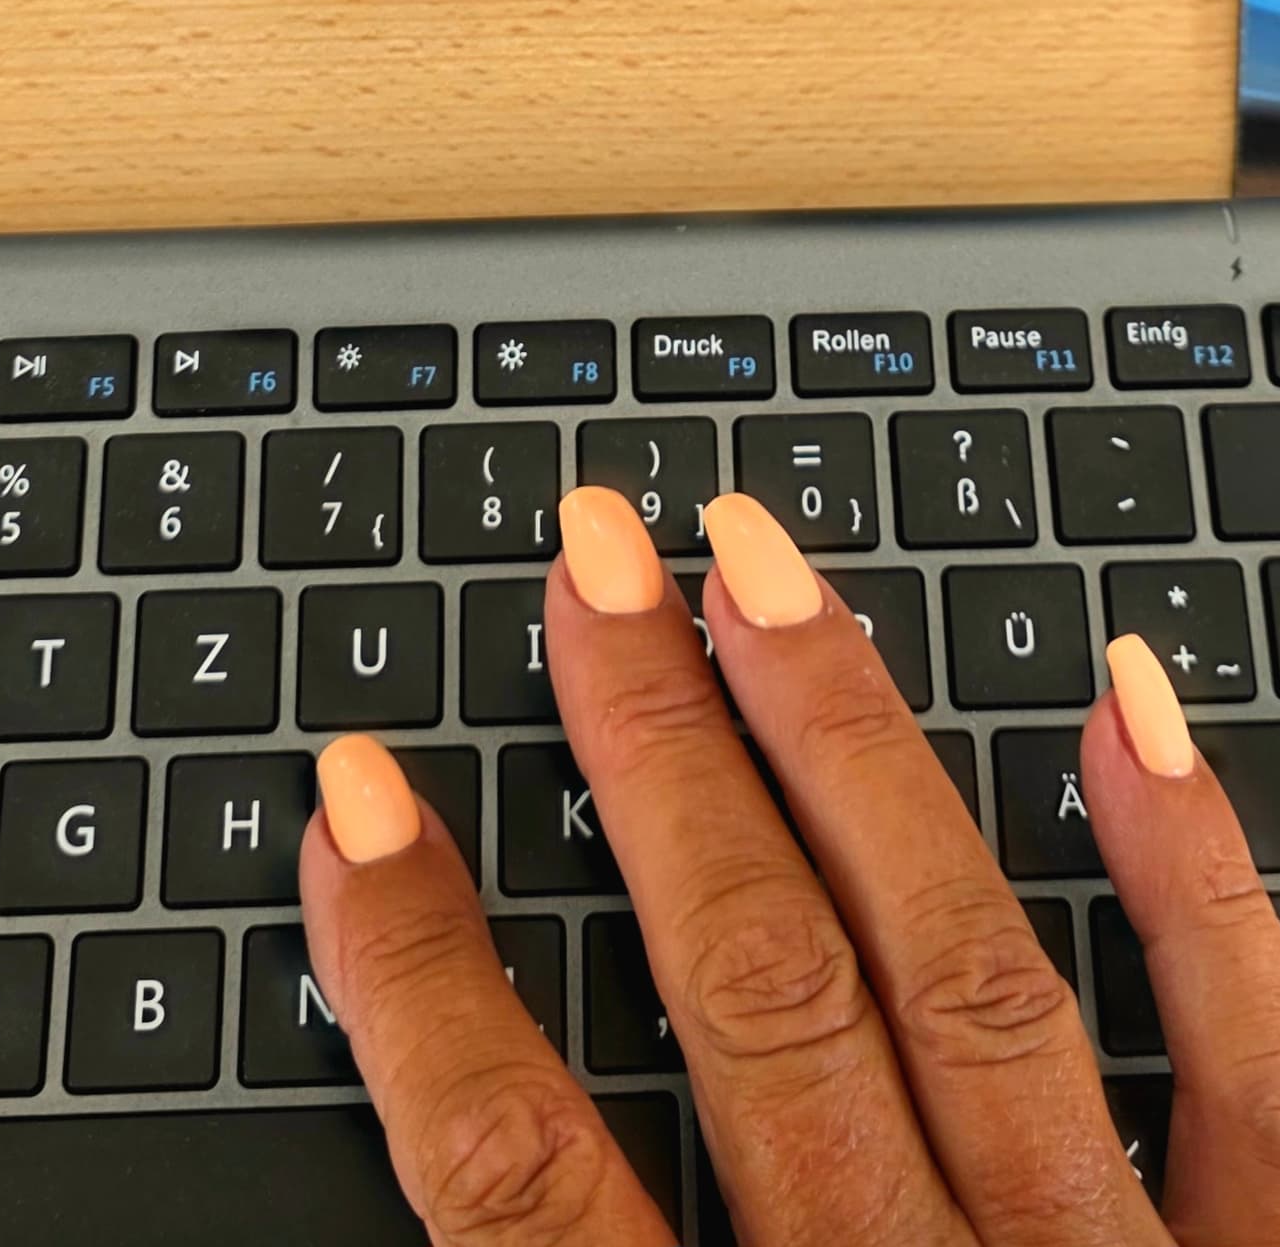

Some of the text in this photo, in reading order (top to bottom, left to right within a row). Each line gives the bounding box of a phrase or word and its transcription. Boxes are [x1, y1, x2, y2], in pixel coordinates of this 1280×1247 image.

[654, 334, 724, 356] Druck
[812, 329, 890, 352] Rollen
[971, 326, 1042, 348] Pause
[1126, 320, 1188, 349] Einfg
[728, 357, 757, 376] F9
[874, 352, 913, 373] F10
[1035, 351, 1074, 369] F11
[1194, 345, 1233, 365] F12
[88, 376, 114, 395] F5
[249, 372, 275, 391] F6
[410, 366, 436, 384] F7
[572, 363, 598, 381] F8
[953, 430, 972, 461] ?
[159, 459, 191, 492] &
[322, 501, 343, 534] 7
[482, 496, 502, 528] 8
[640, 491, 662, 523] 9
[801, 486, 822, 518] 0
[1, 511, 21, 544] 5
[160, 506, 182, 539] 6
[526, 623, 543, 670] I
[1005, 611, 1035, 656] Ü
[32, 638, 66, 687] T
[193, 633, 230, 682] Z
[353, 627, 387, 675] U
[1058, 772, 1088, 820] Ä
[56, 804, 95, 856] G
[222, 799, 260, 850] H
[563, 789, 594, 839] K
[133, 979, 165, 1031] B
